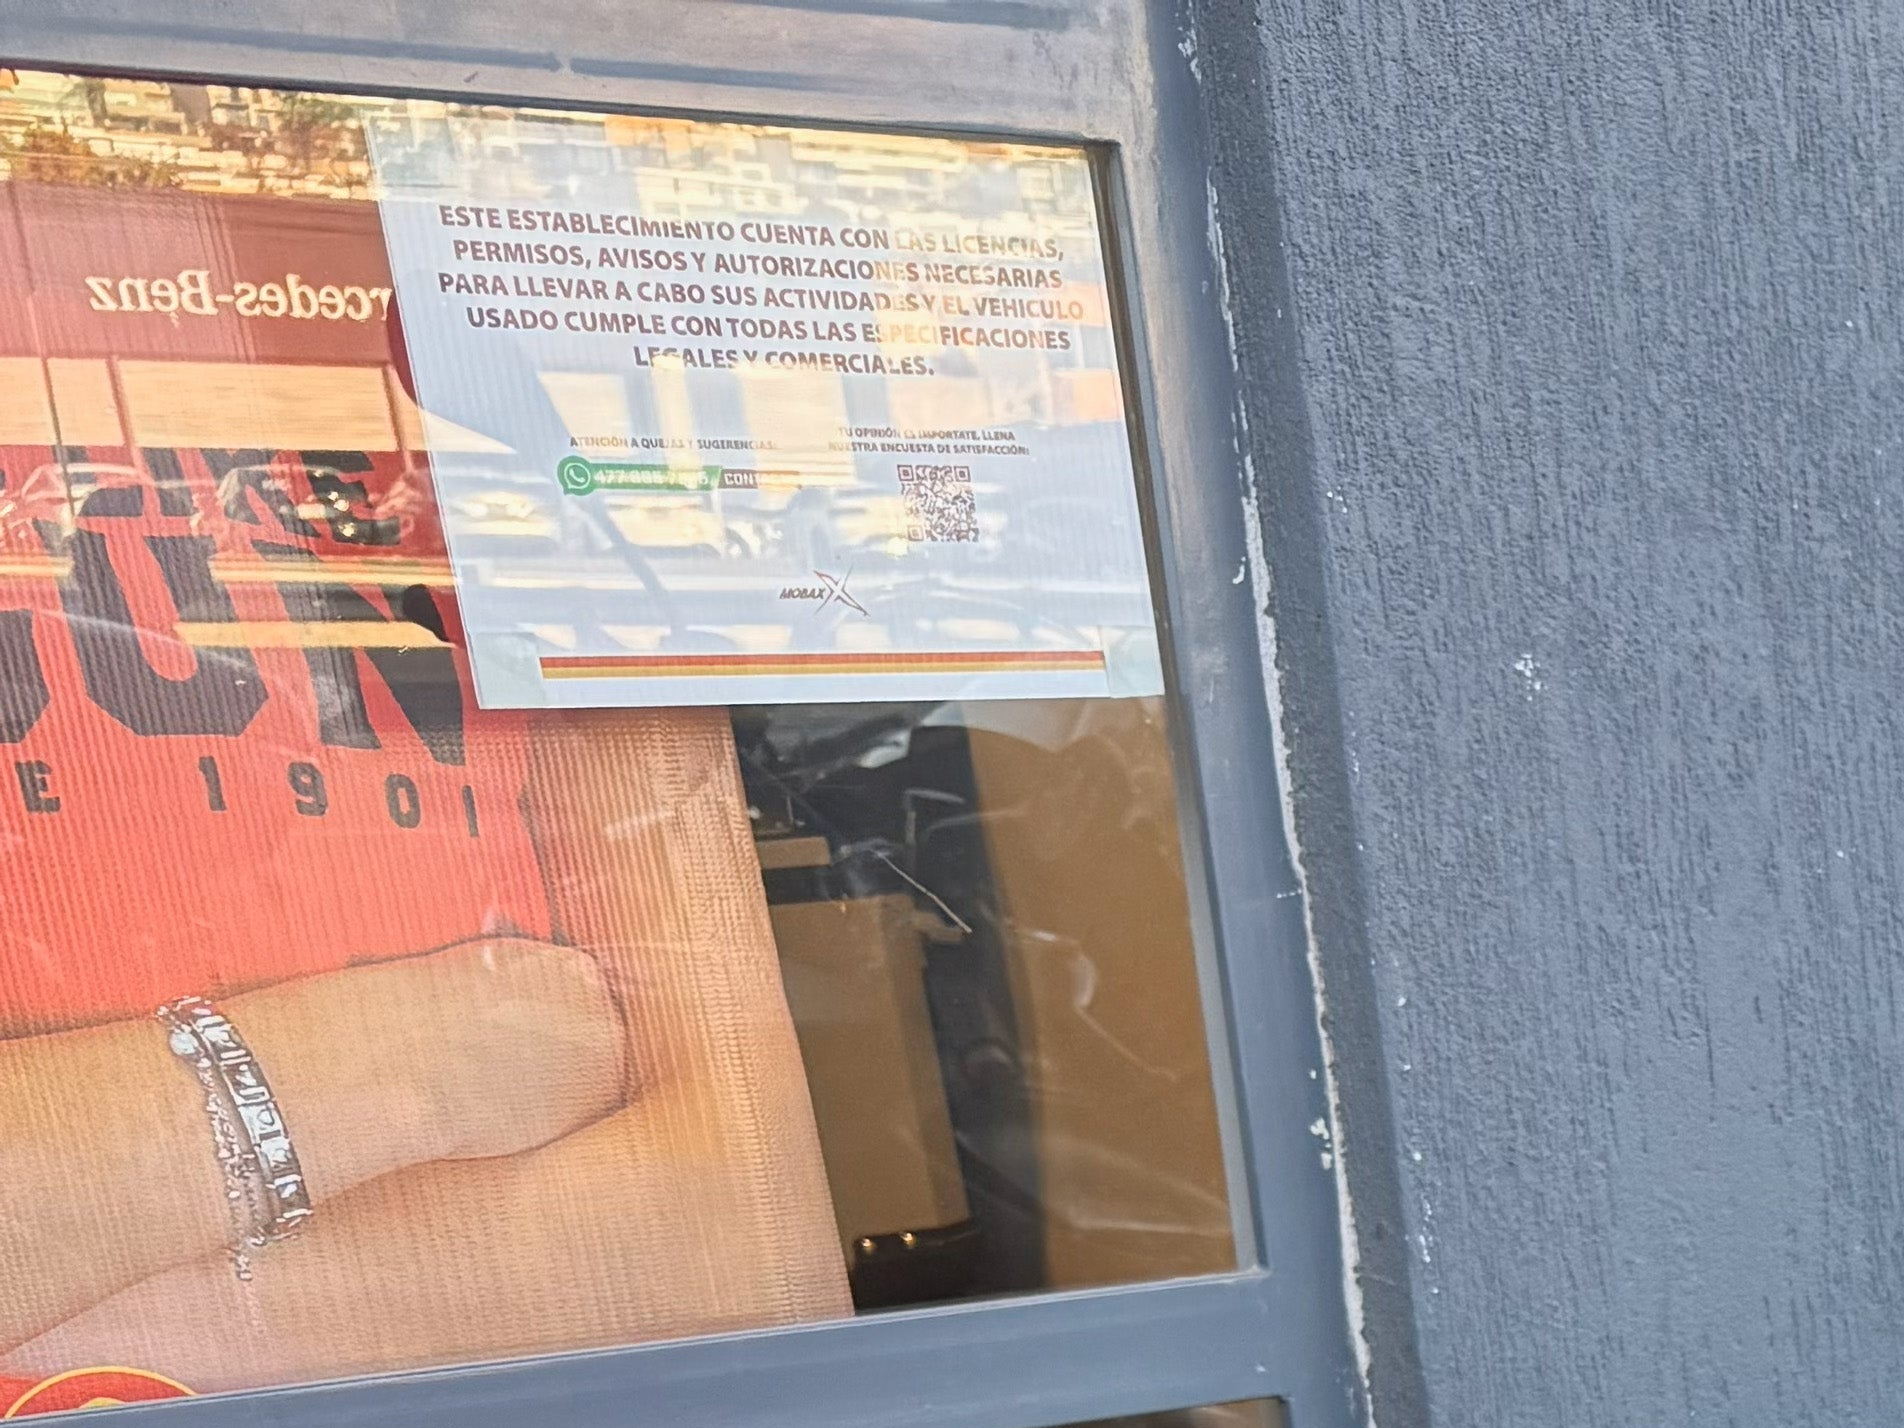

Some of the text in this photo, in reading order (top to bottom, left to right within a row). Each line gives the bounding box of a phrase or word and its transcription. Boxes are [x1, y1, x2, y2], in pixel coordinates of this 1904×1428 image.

[439, 205, 502, 229] ESTE
[507, 209, 734, 241] ESTABLECIMIENTO
[740, 221, 835, 247] CUENTA
[839, 226, 889, 250] CON
[895, 230, 937, 253] LAS
[453, 239, 1063, 289] PERMISOS, AVISOS Y AUTORIZACIONES NECESARIAS
[438, 272, 1084, 321] PARA LLEVAR A CABO SUS ACTIVIDADES Y EL VEHICULO
[466, 306, 1071, 350] USADO CUMPLE CON TODAS LAS ESPECIFICACIONES
[765, 350, 935, 376] COMERCIALES.
[938, 444, 951, 454] DE
[0, 519, 466, 768] UN
[199, 756, 480, 838] 1901
